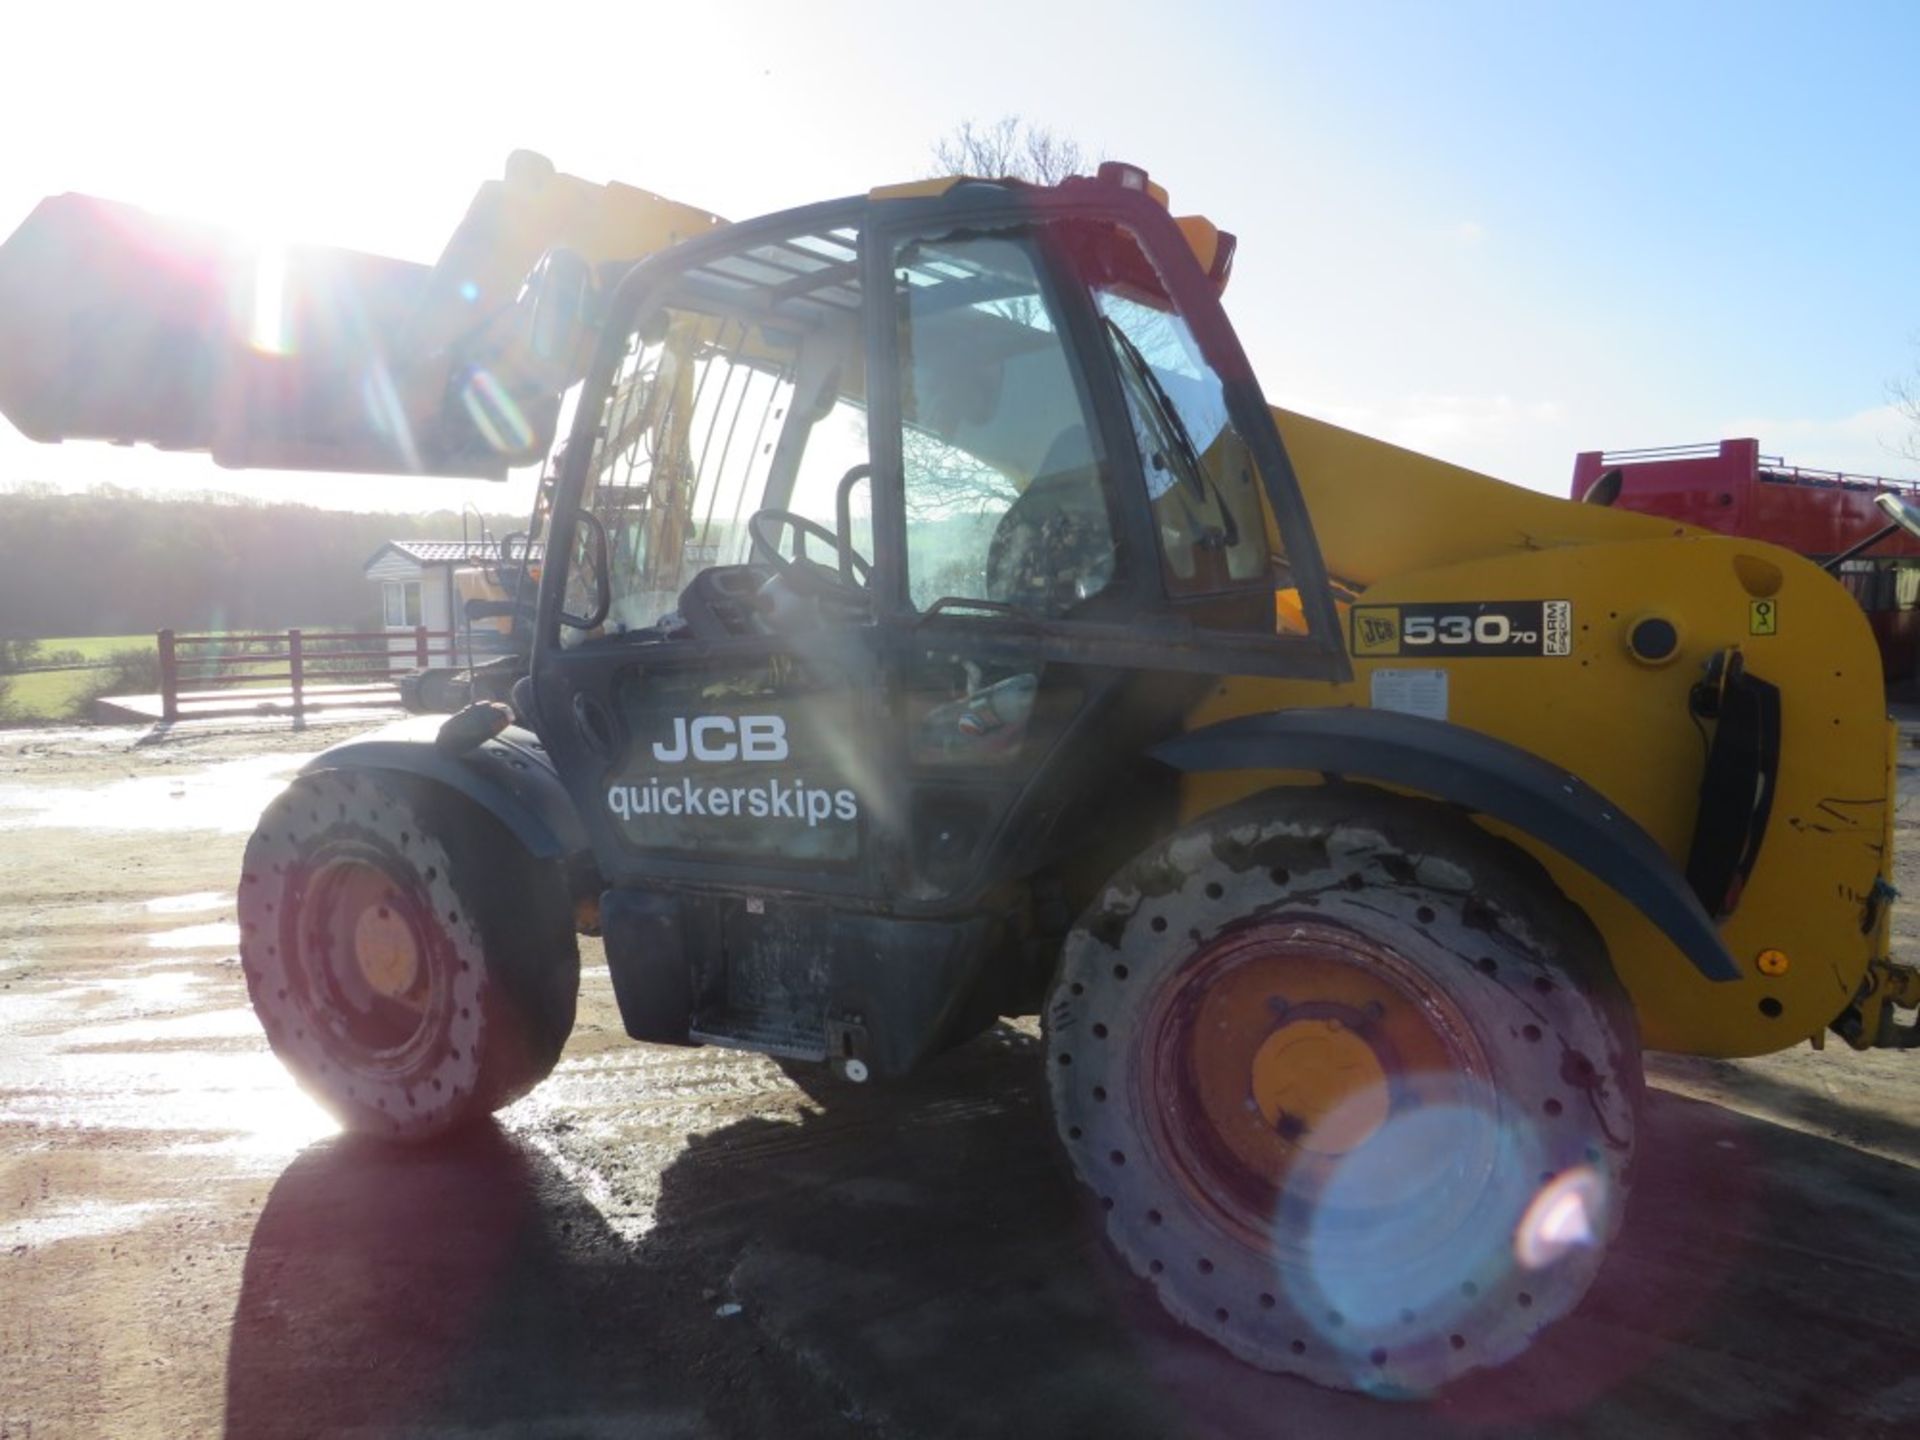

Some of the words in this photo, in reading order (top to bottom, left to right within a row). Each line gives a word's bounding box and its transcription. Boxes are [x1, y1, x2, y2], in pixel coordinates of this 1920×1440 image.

[1403, 615, 1511, 644] 530
[1510, 631, 1537, 644] 70
[1546, 603, 1558, 653] FARM
[1558, 603, 1568, 653] SPECIAL
[652, 715, 789, 762] JCB
[608, 777, 858, 827] quickerskips
